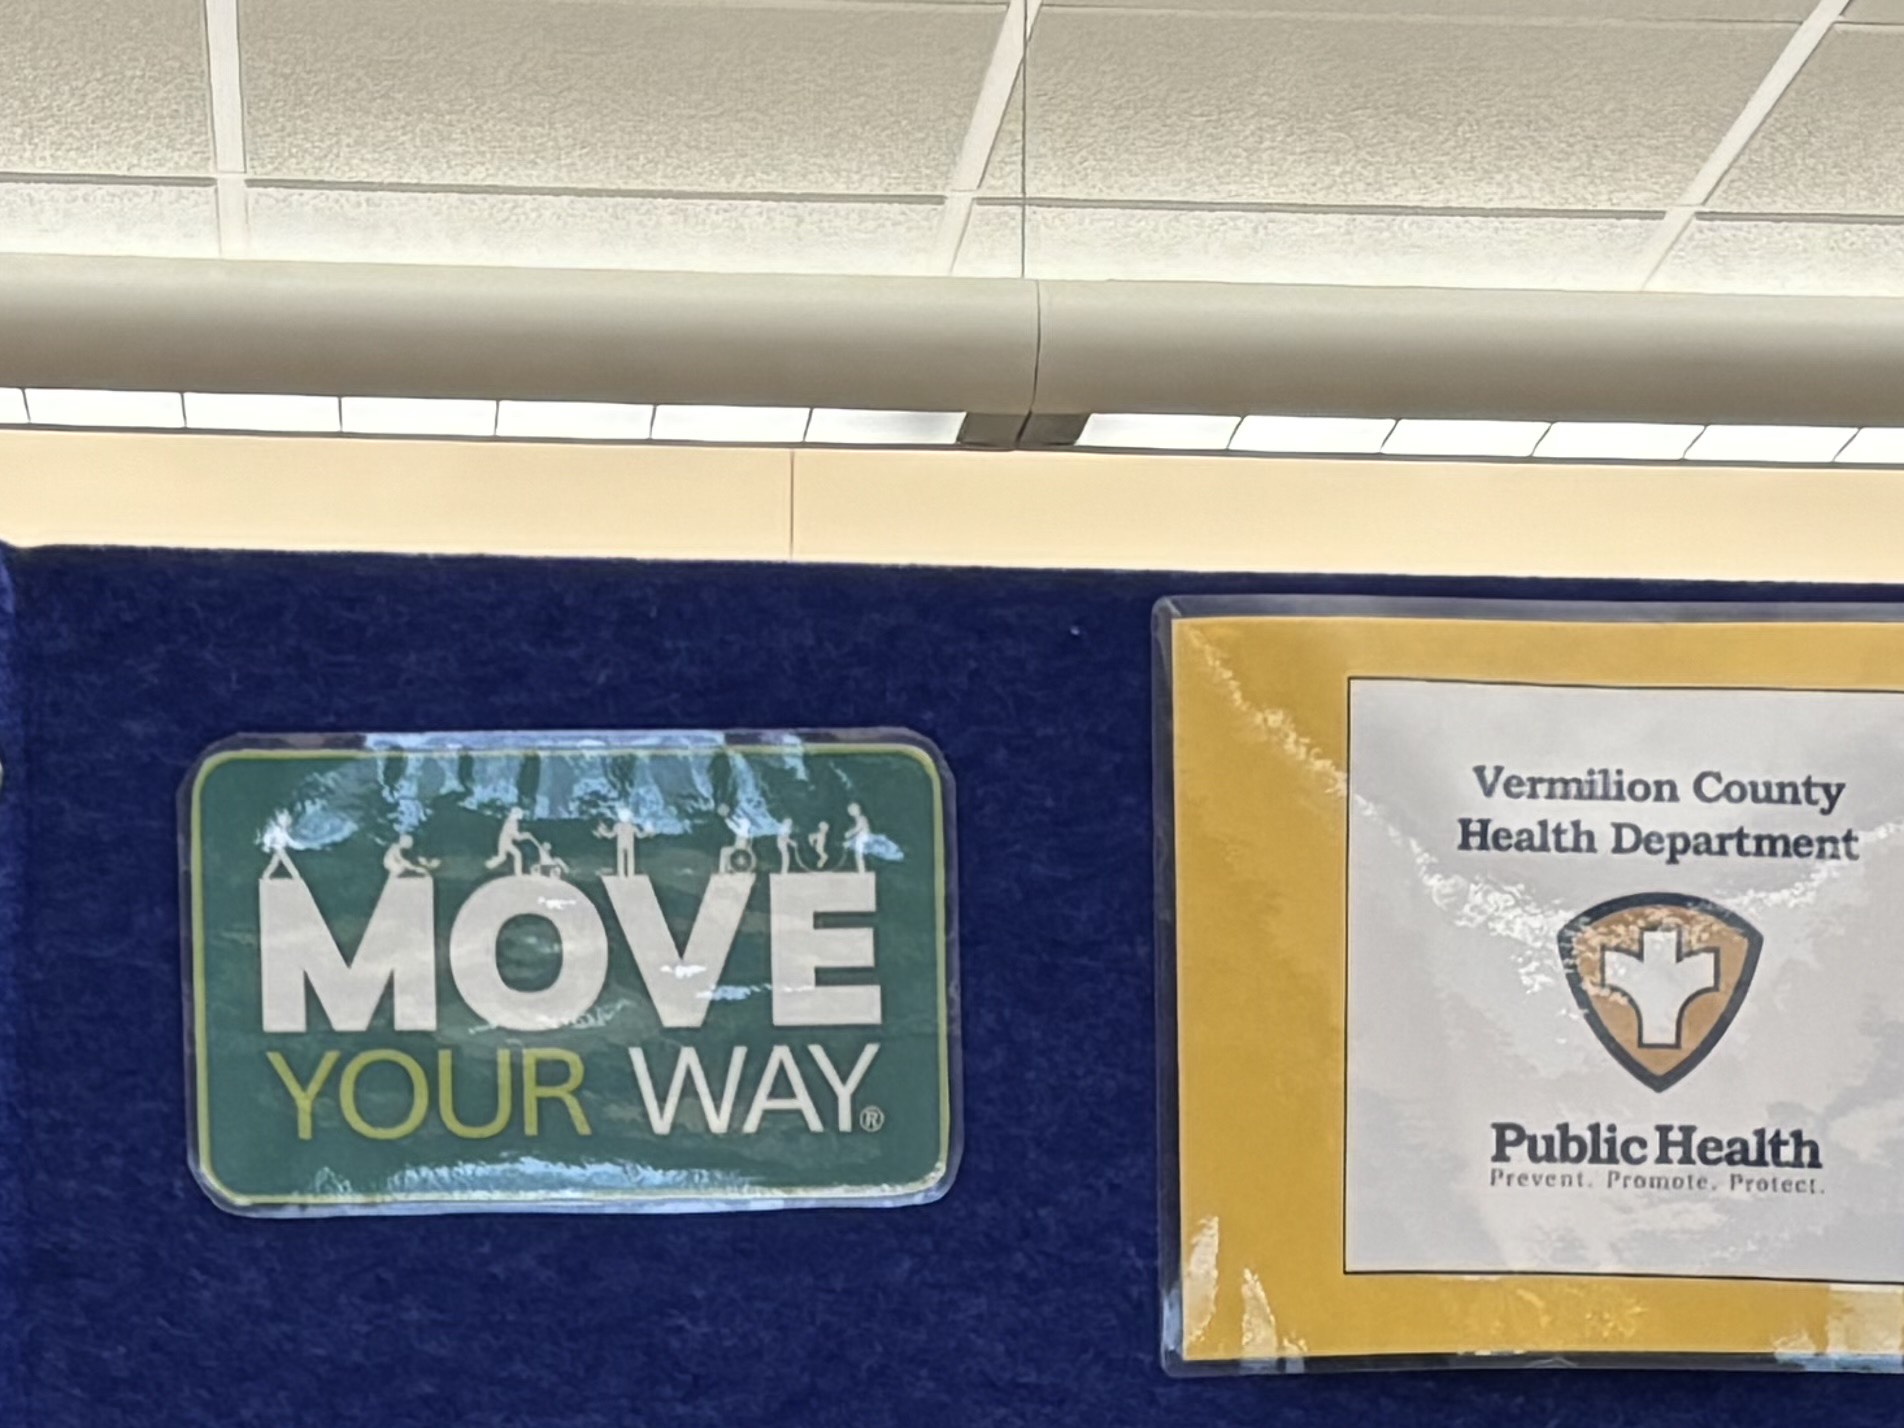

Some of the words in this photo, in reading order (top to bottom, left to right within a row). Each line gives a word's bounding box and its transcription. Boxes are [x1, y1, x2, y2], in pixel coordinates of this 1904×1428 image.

[1472, 765, 1680, 803] Vermilion
[1692, 770, 1846, 816] County
[1457, 817, 1598, 854] Health
[1611, 822, 1860, 865] Department
[258, 869, 884, 1034] MOVE
[266, 1041, 590, 1140] YOUR
[1490, 1121, 1650, 1166] Public
[1654, 1124, 1823, 1169] Health
[1489, 1167, 1594, 1189] Prevent.
[1605, 1168, 1718, 1192] Promote.
[1728, 1172, 1826, 1195] Protect.
